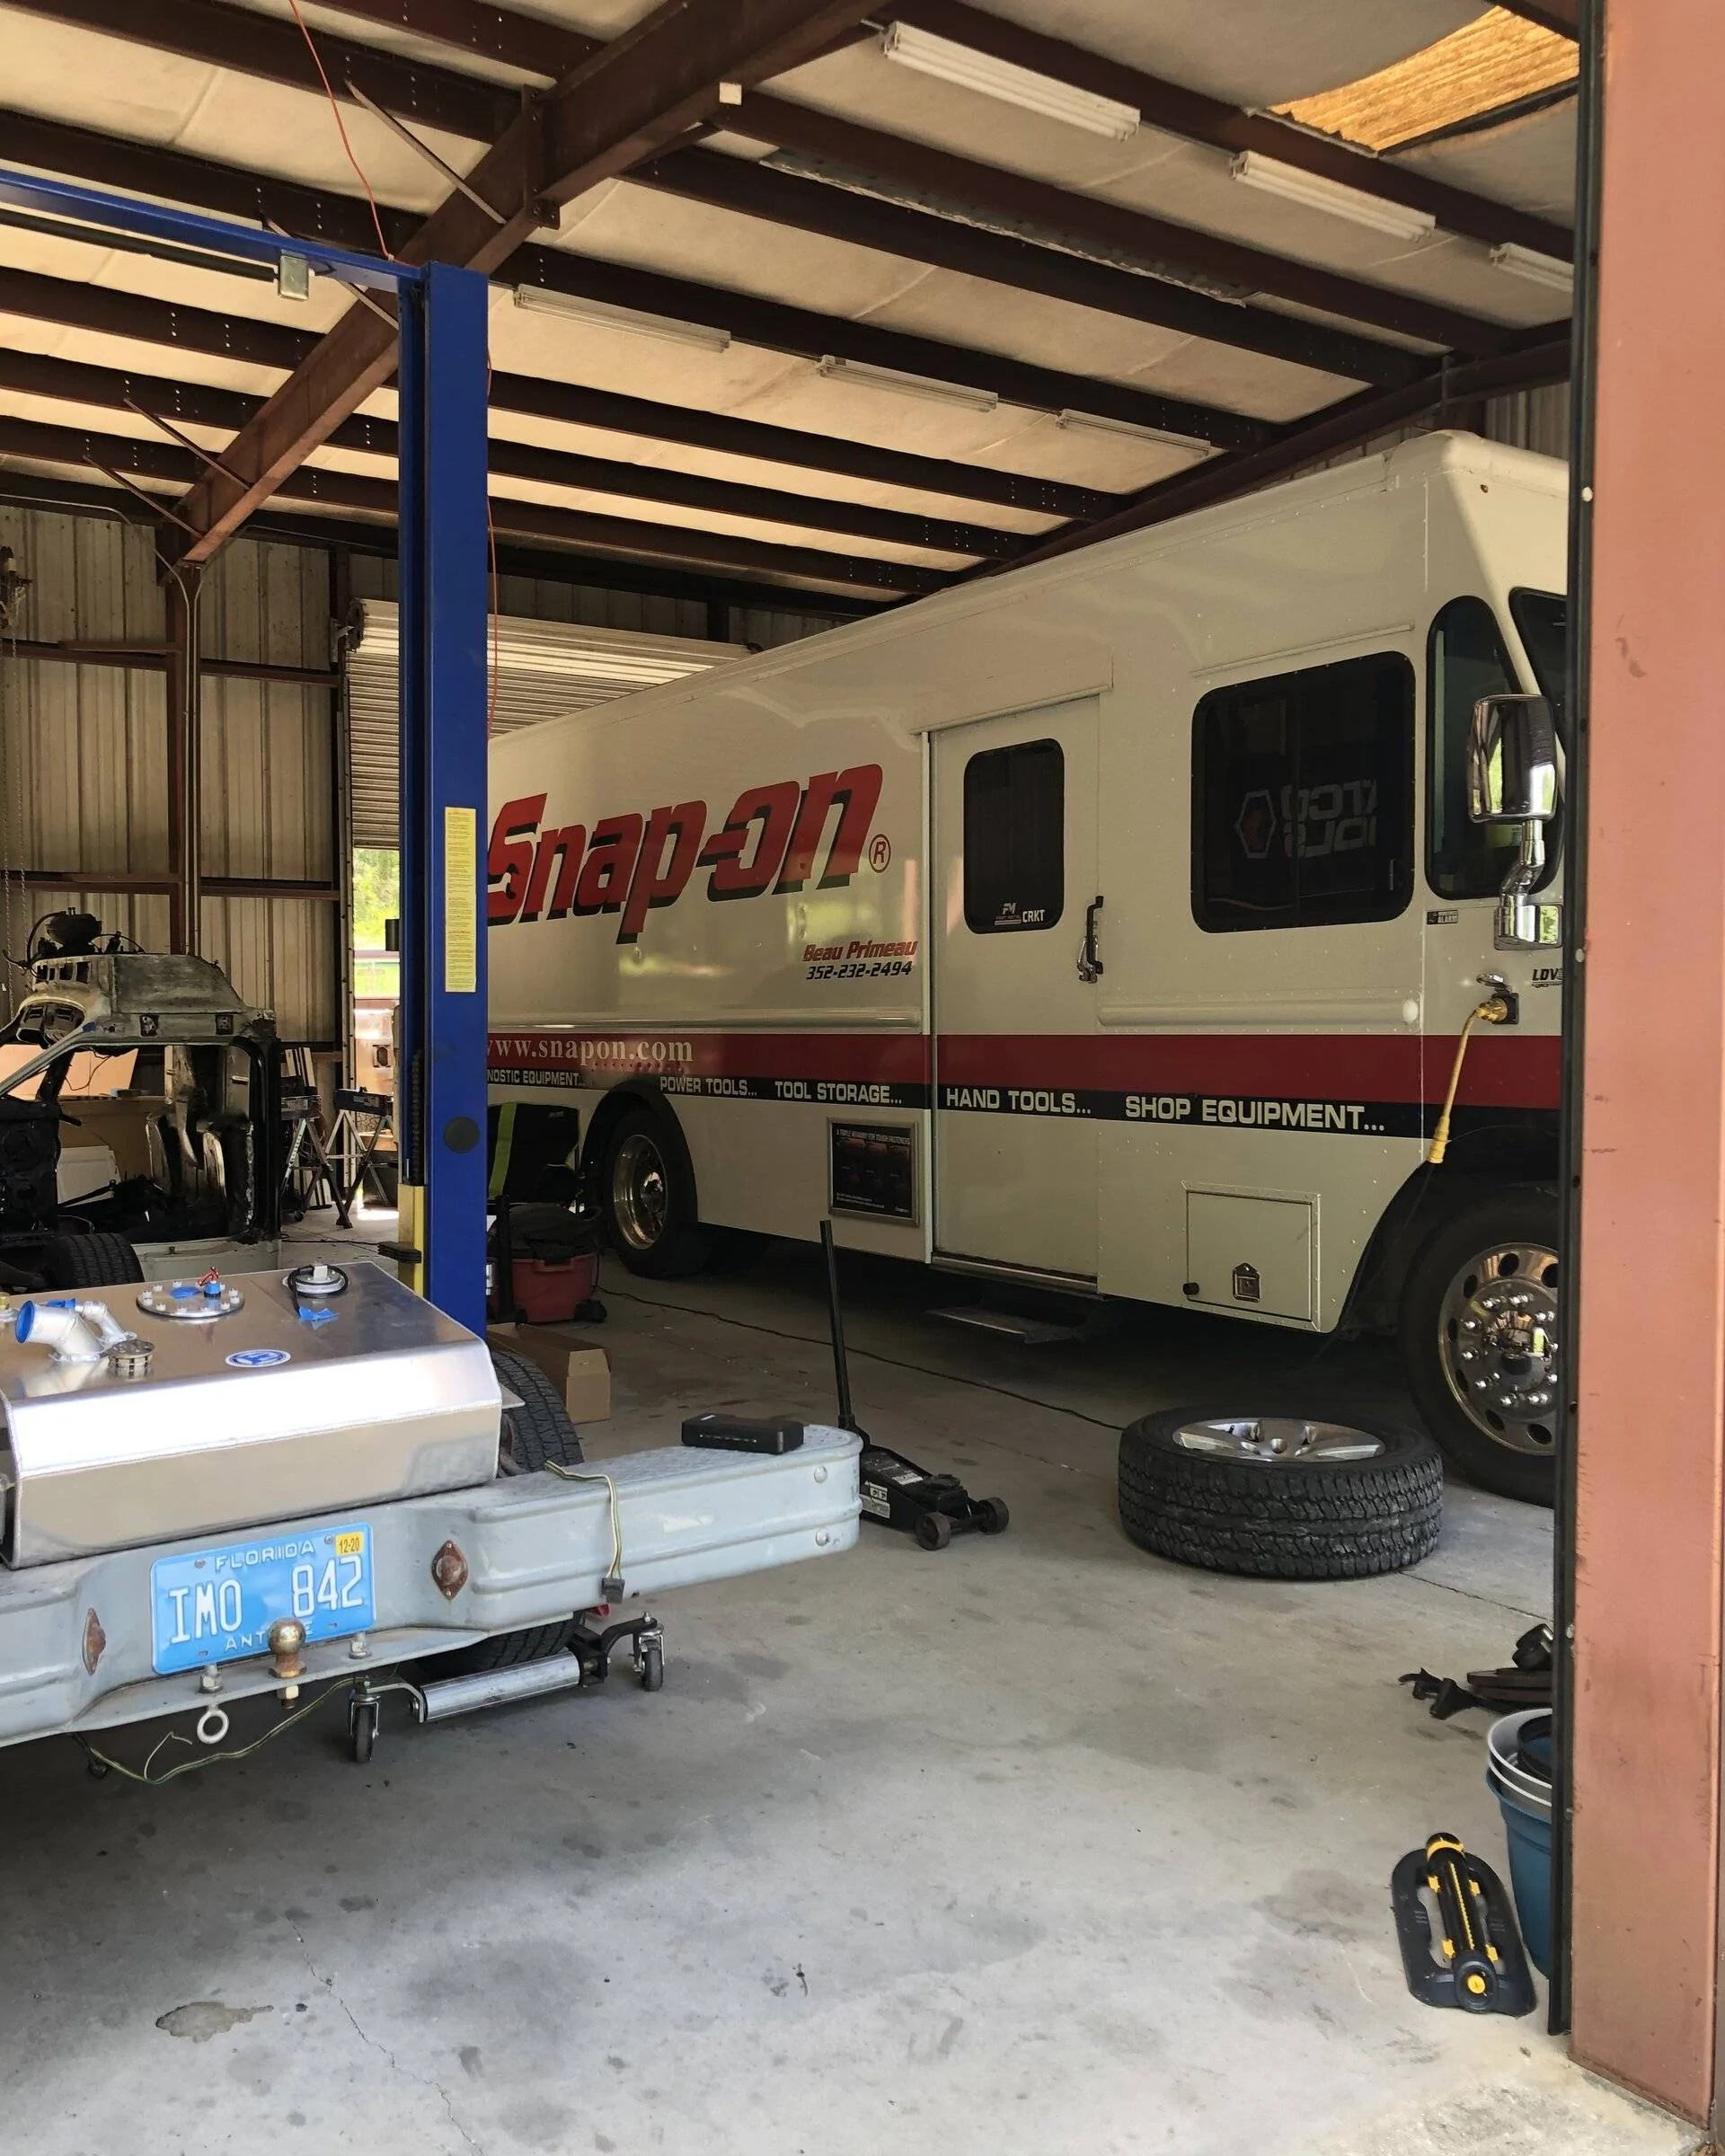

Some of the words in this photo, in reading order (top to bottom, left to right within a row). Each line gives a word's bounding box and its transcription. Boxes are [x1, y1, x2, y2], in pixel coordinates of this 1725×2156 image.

[487, 764, 883, 944] Snap-on
[1022, 909, 1045, 923] CRKT
[802, 944, 844, 961] Beau
[846, 940, 918, 959] Primeau
[806, 960, 913, 980] 352-232-2494
[487, 1039, 694, 1067] ww.snapon.com
[487, 1069, 520, 1084] NOSTIC
[659, 1076, 702, 1093] POWER
[774, 1081, 812, 1100] TOOL
[817, 1082, 902, 1105] STORAGE...
[946, 1088, 1000, 1109] HAND
[1007, 1091, 1092, 1114] TOOLS...
[1125, 1095, 1191, 1120] SHOP
[1202, 1099, 1385, 1131] EQUIPMENT...
[216, 1540, 314, 1571] FLORIDA
[339, 1537, 360, 1554] 12-20
[292, 1555, 363, 1618] 842
[225, 1620, 313, 1651] ANTE
